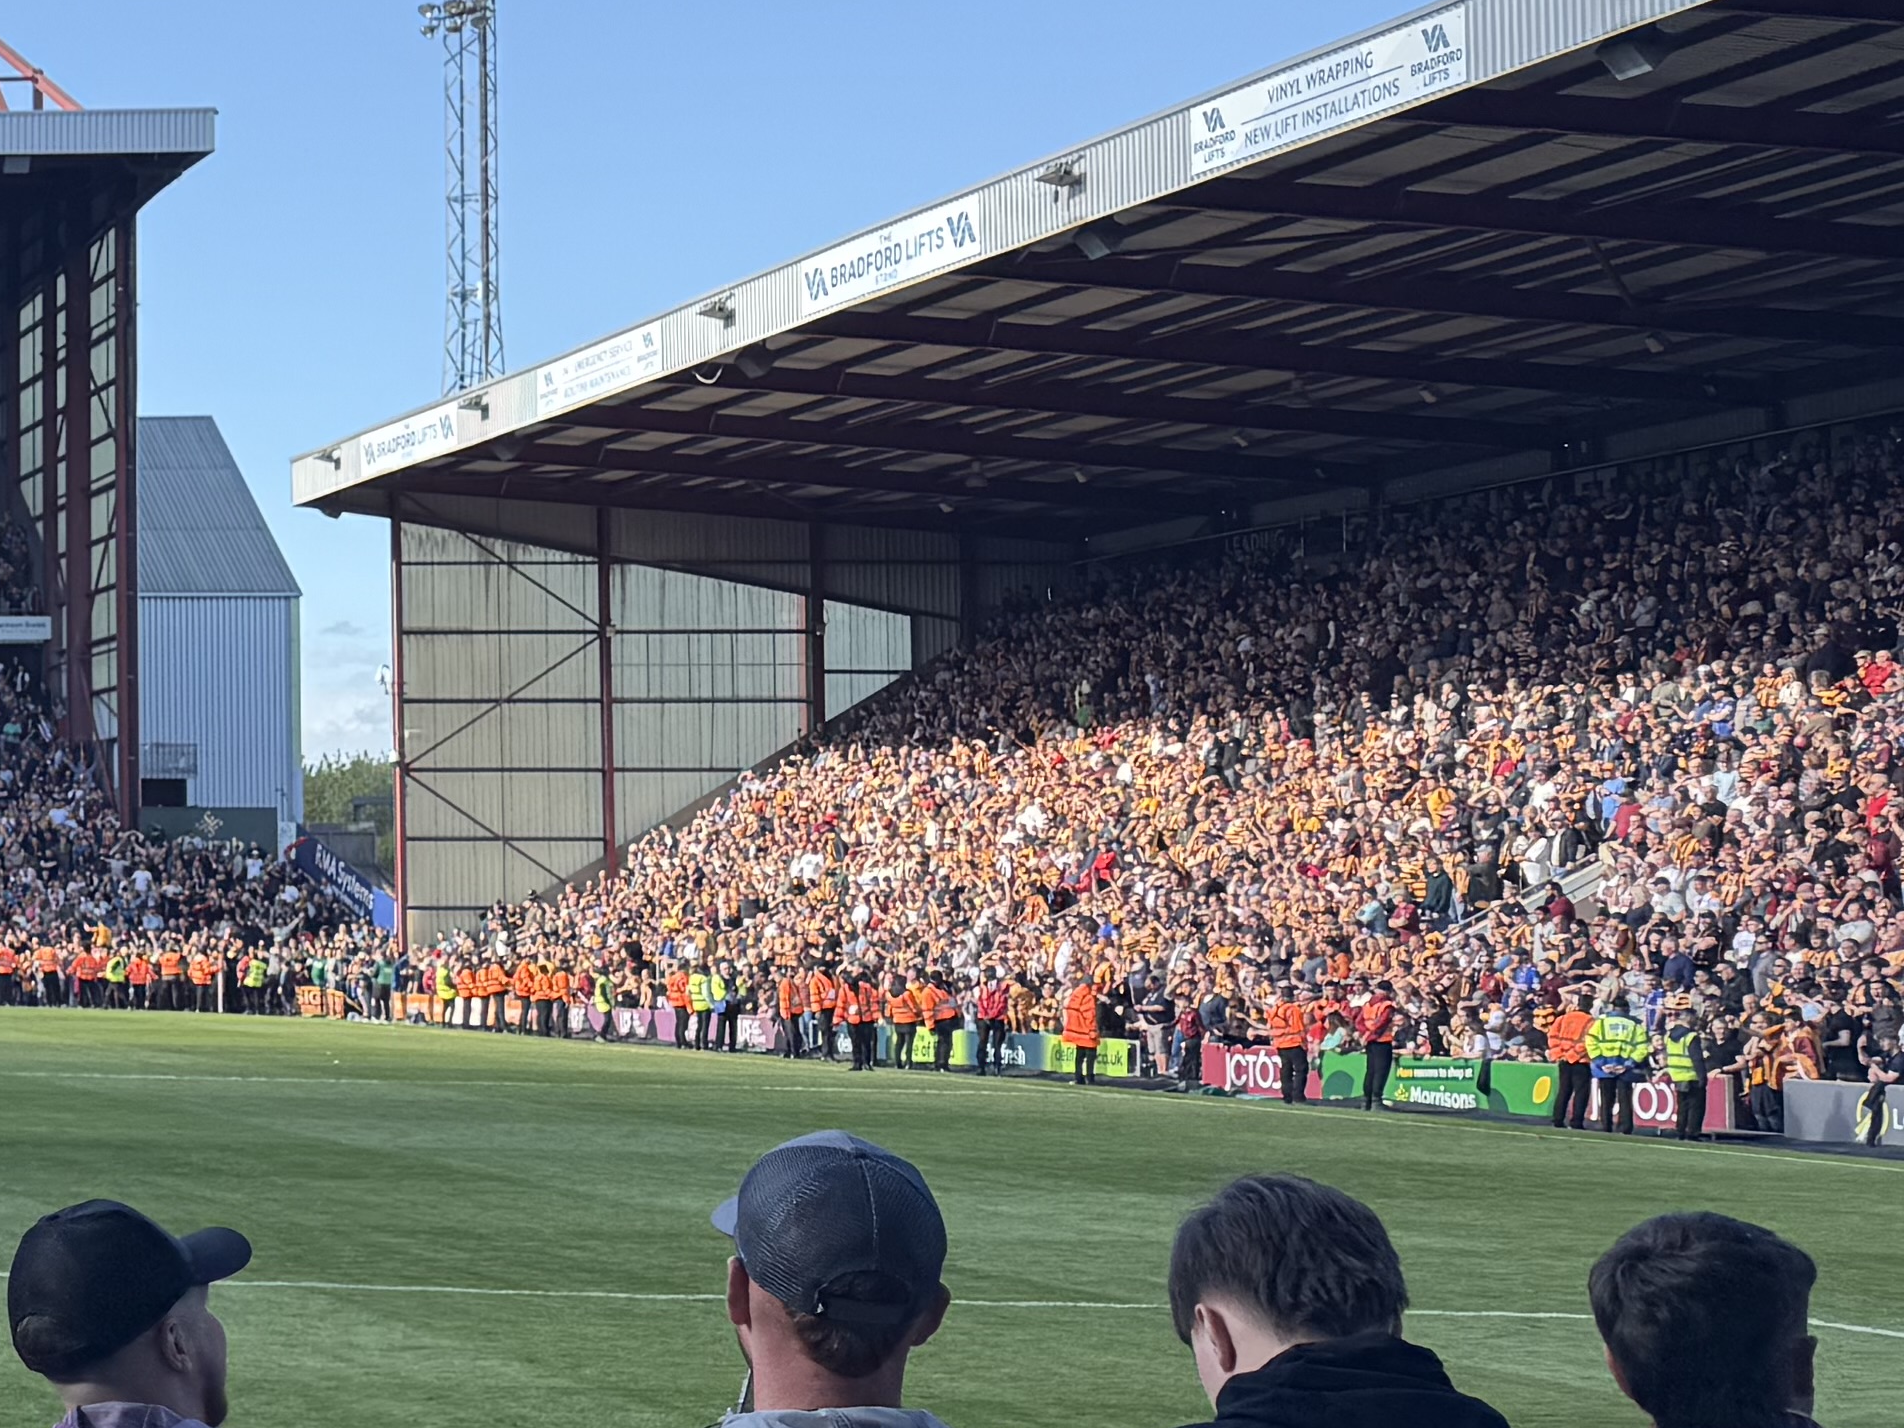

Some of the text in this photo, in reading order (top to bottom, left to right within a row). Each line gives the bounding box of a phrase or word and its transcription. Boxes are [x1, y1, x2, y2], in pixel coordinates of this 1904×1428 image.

[1410, 49, 1462, 77] BRADFORD
[1267, 51, 1374, 105] VINYL WRAPPING
[1423, 68, 1450, 88] LIFTS
[1244, 78, 1401, 149] NEW LIFT INSTALLATIONS
[1194, 129, 1236, 155] BRADFORD
[1203, 147, 1225, 164] LIFTS
[830, 226, 944, 288] BRADFORD LIFTS
[338, 861, 374, 911] Systems
[1409, 1085, 1477, 1110] Morrisons
